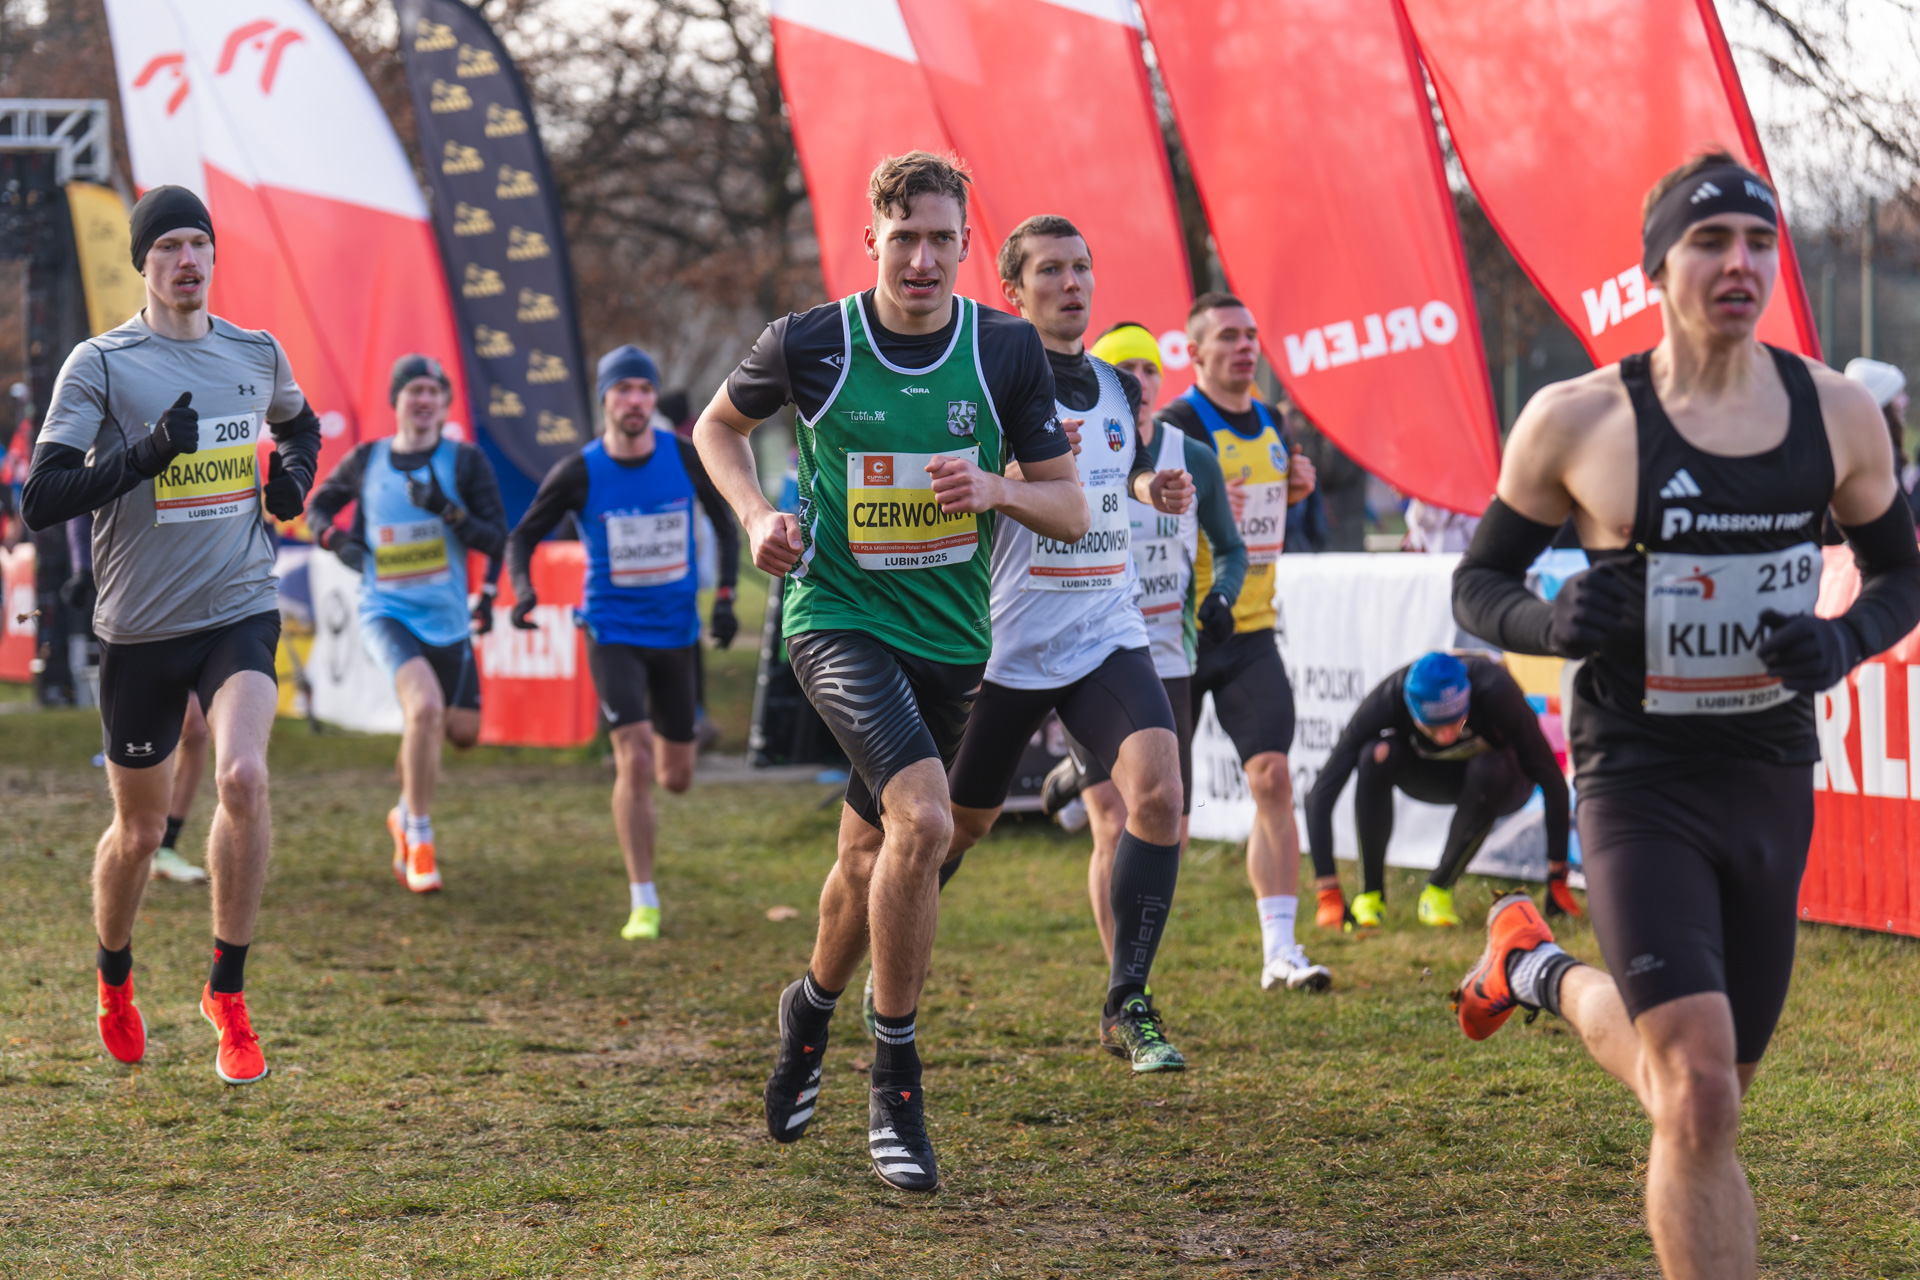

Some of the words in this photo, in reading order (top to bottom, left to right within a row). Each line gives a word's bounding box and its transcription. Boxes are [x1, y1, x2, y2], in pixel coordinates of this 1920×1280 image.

[215, 420, 250, 442] 208
[159, 455, 254, 488] KRAKOWIAK
[188, 508, 217, 518] LUBIN
[218, 505, 239, 515] 2025
[1102, 493, 1118, 513] 88
[853, 502, 972, 528] CZERWON
[1696, 514, 1774, 532] PASSION
[884, 557, 919, 566] LUBIN
[921, 552, 948, 565] 2025
[1145, 545, 1168, 562] 71
[1061, 580, 1089, 588] LUBIN
[1091, 578, 1112, 587] 2025
[1757, 555, 1812, 594] 218
[1696, 695, 1745, 708] LUBIN
[1124, 894, 1168, 978] kalenji
